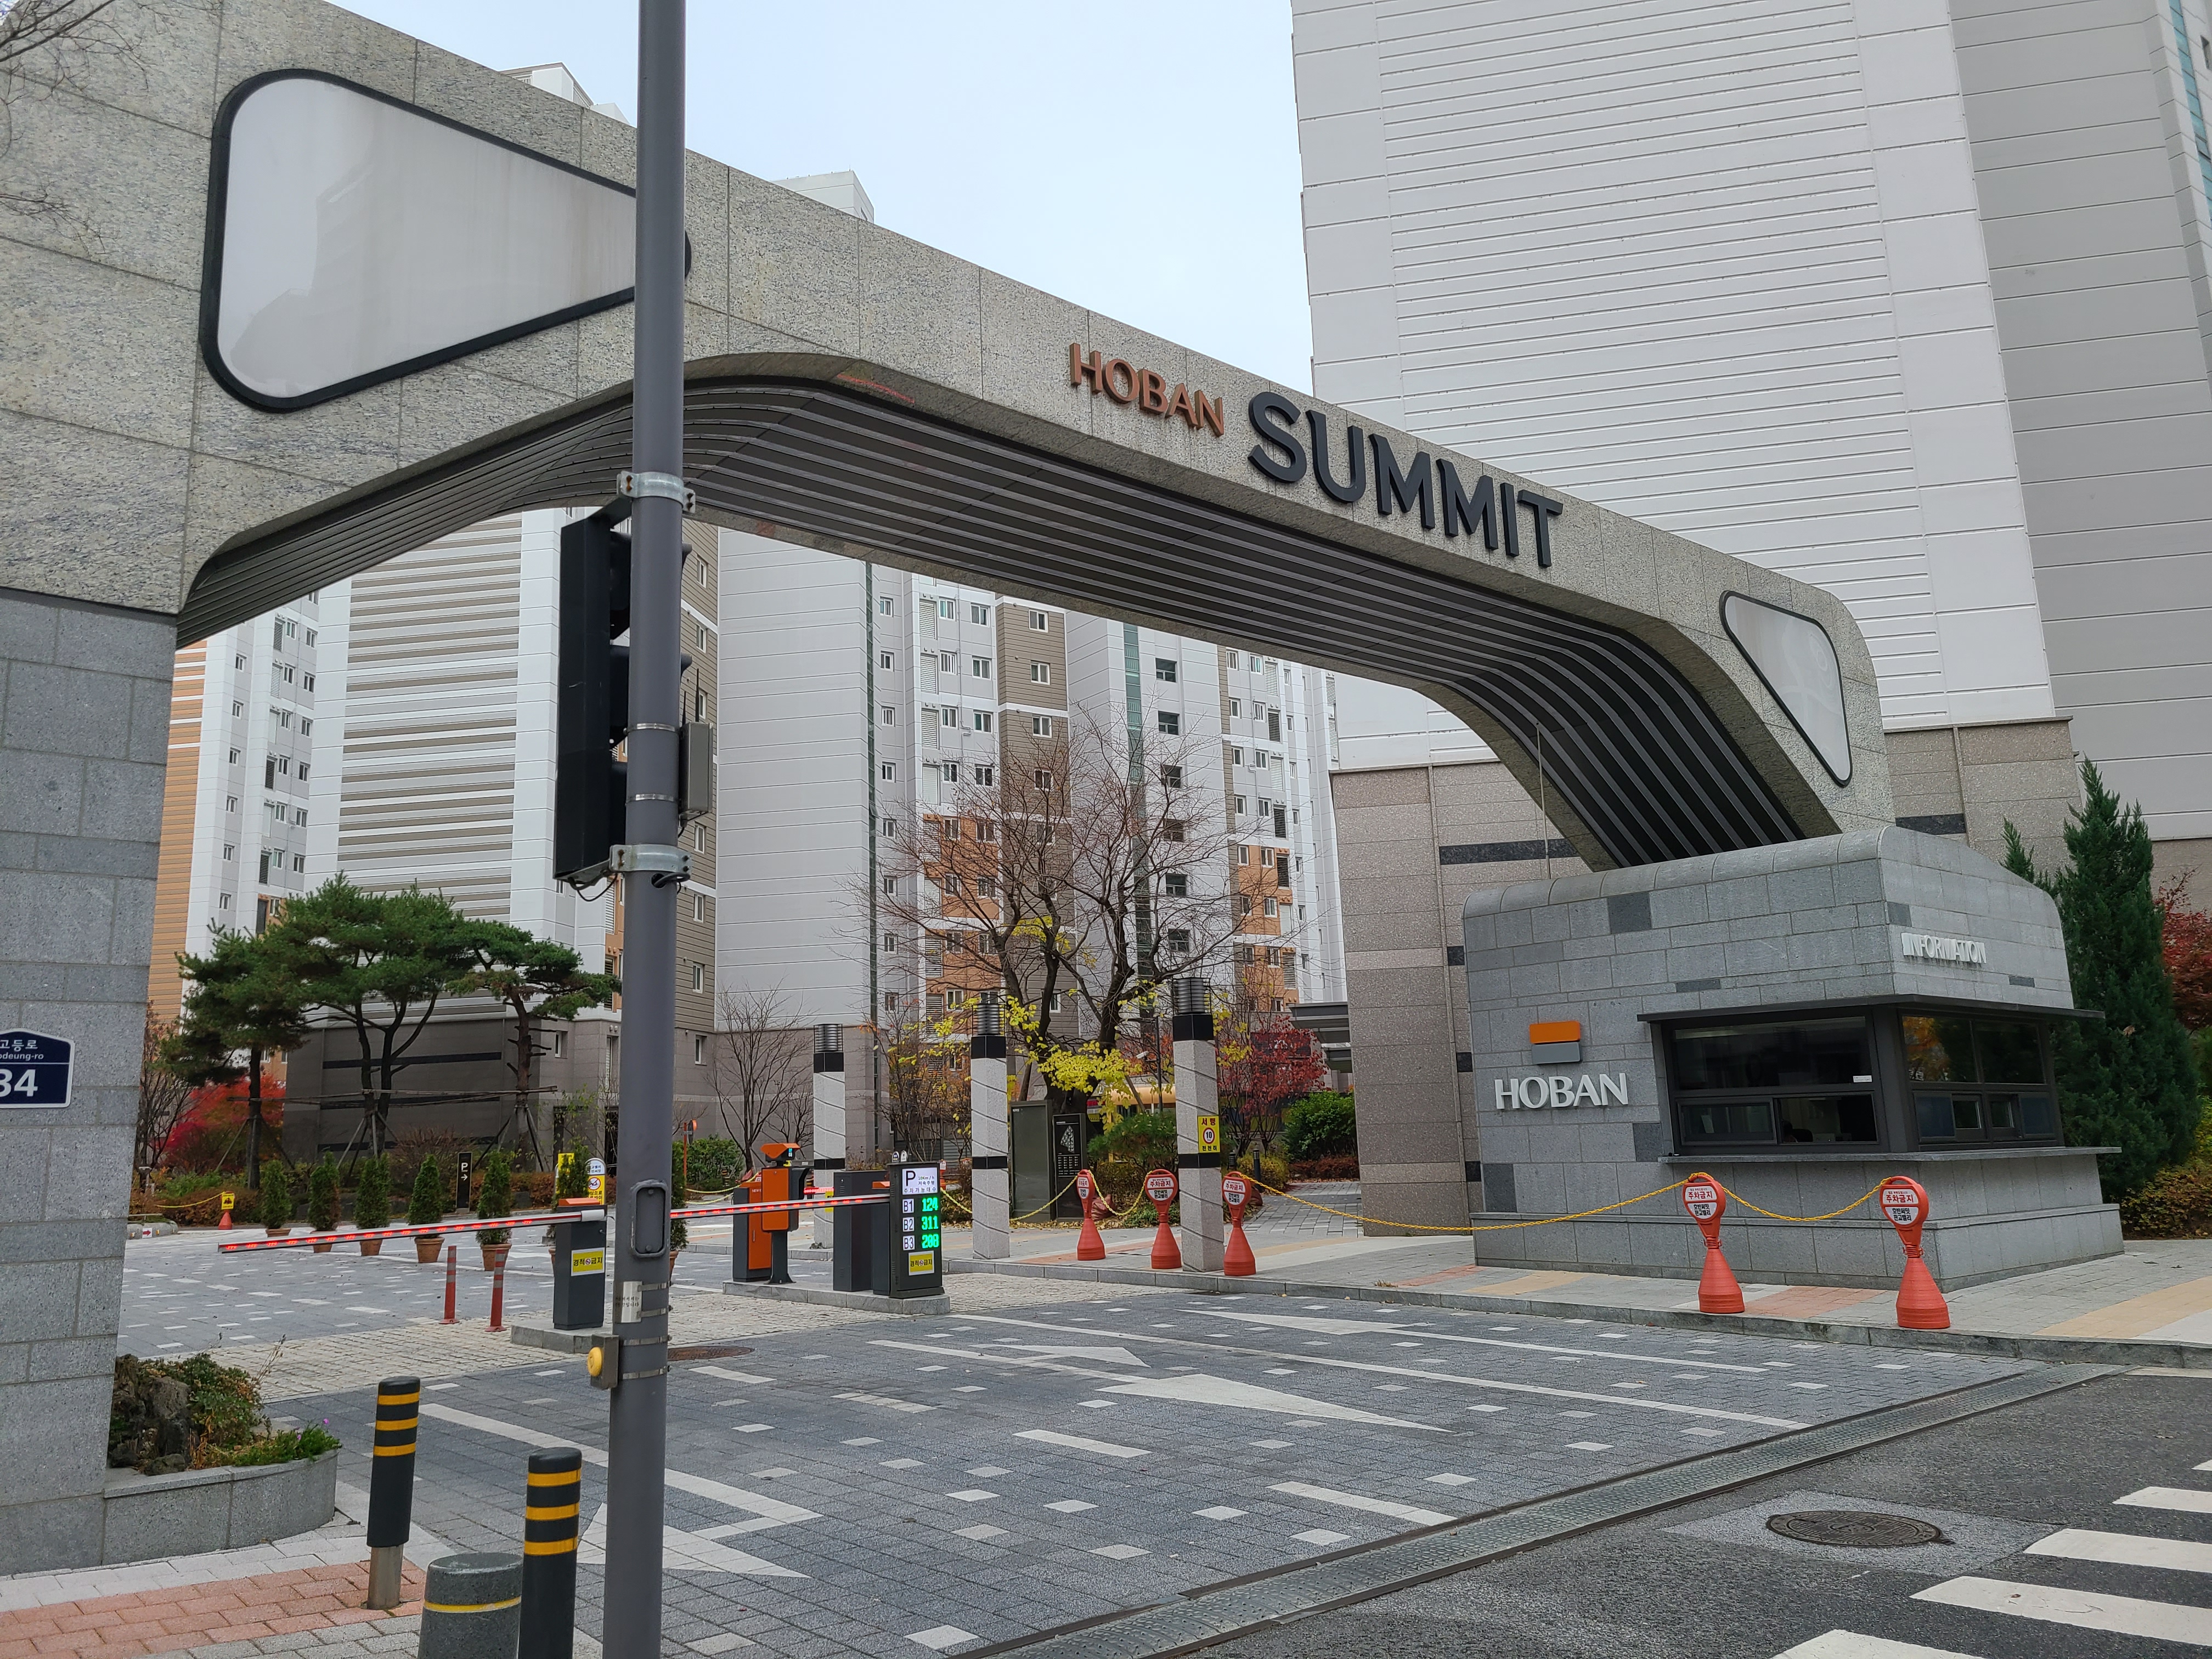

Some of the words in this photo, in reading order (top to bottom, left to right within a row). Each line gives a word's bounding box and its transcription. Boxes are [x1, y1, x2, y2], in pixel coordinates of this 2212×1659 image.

[1070, 342, 1224, 437] HOBAN
[1248, 391, 1564, 568] SUMMIT
[1901, 932, 1987, 964] INFORMATION
[0, 1040, 38, 1052] 고등로
[1494, 1073, 1628, 1109] HOBAN
[461, 1162, 469, 1171] P
[906, 1170, 916, 1187] P
[1226, 1183, 1243, 1192] 주차금지
[1688, 1190, 1713, 1199] 주차금지
[1886, 1194, 1914, 1203] 주차금지
[904, 1200, 913, 1212] B1
[922, 1197, 939, 1212] 124
[904, 1218, 913, 1231] B2
[921, 1215, 939, 1230] 311
[904, 1237, 914, 1249] B3
[922, 1233, 939, 1249] 208
[573, 1258, 585, 1266] 경적
